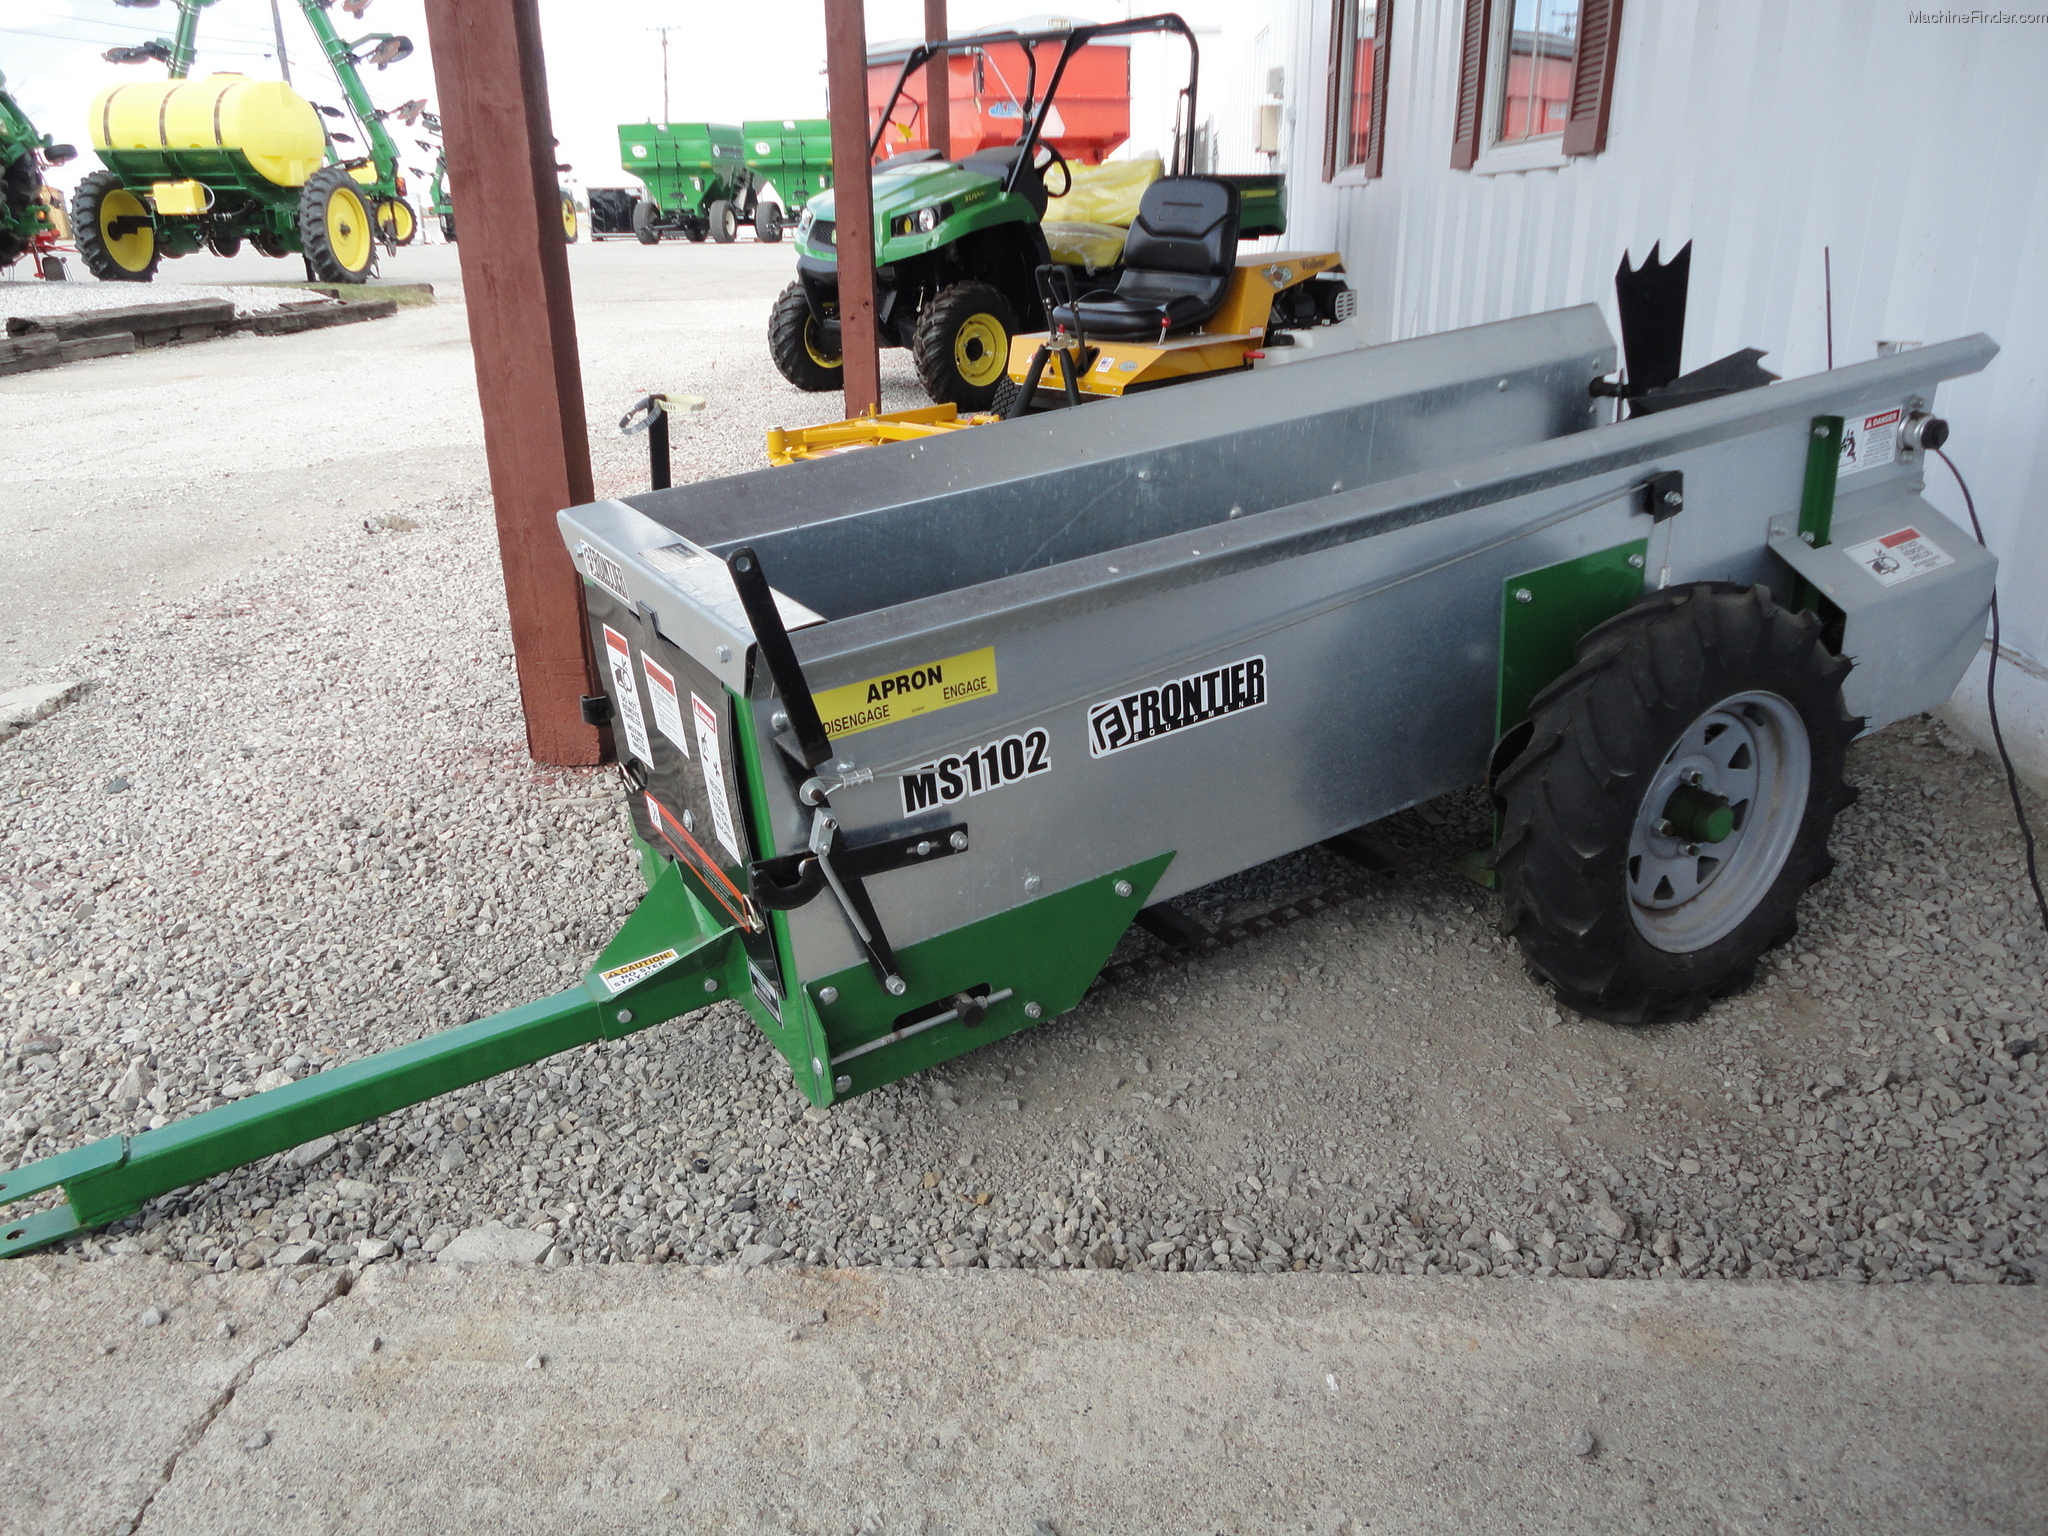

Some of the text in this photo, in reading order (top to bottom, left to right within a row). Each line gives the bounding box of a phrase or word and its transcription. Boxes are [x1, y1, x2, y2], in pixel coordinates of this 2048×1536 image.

[1872, 411, 1898, 427] DANGER
[866, 665, 943, 704] APRON
[943, 676, 988, 700] ENGAGE
[1121, 658, 1265, 736] FRONTIER
[822, 704, 891, 735] DISENGAGE
[1132, 696, 1258, 742] EQUIPMENT
[902, 730, 1048, 814] MS1102
[620, 952, 671, 974] CAUTION!
[620, 971, 637, 980] NO
[639, 961, 665, 973] STEP
[613, 975, 641, 988] STAY
